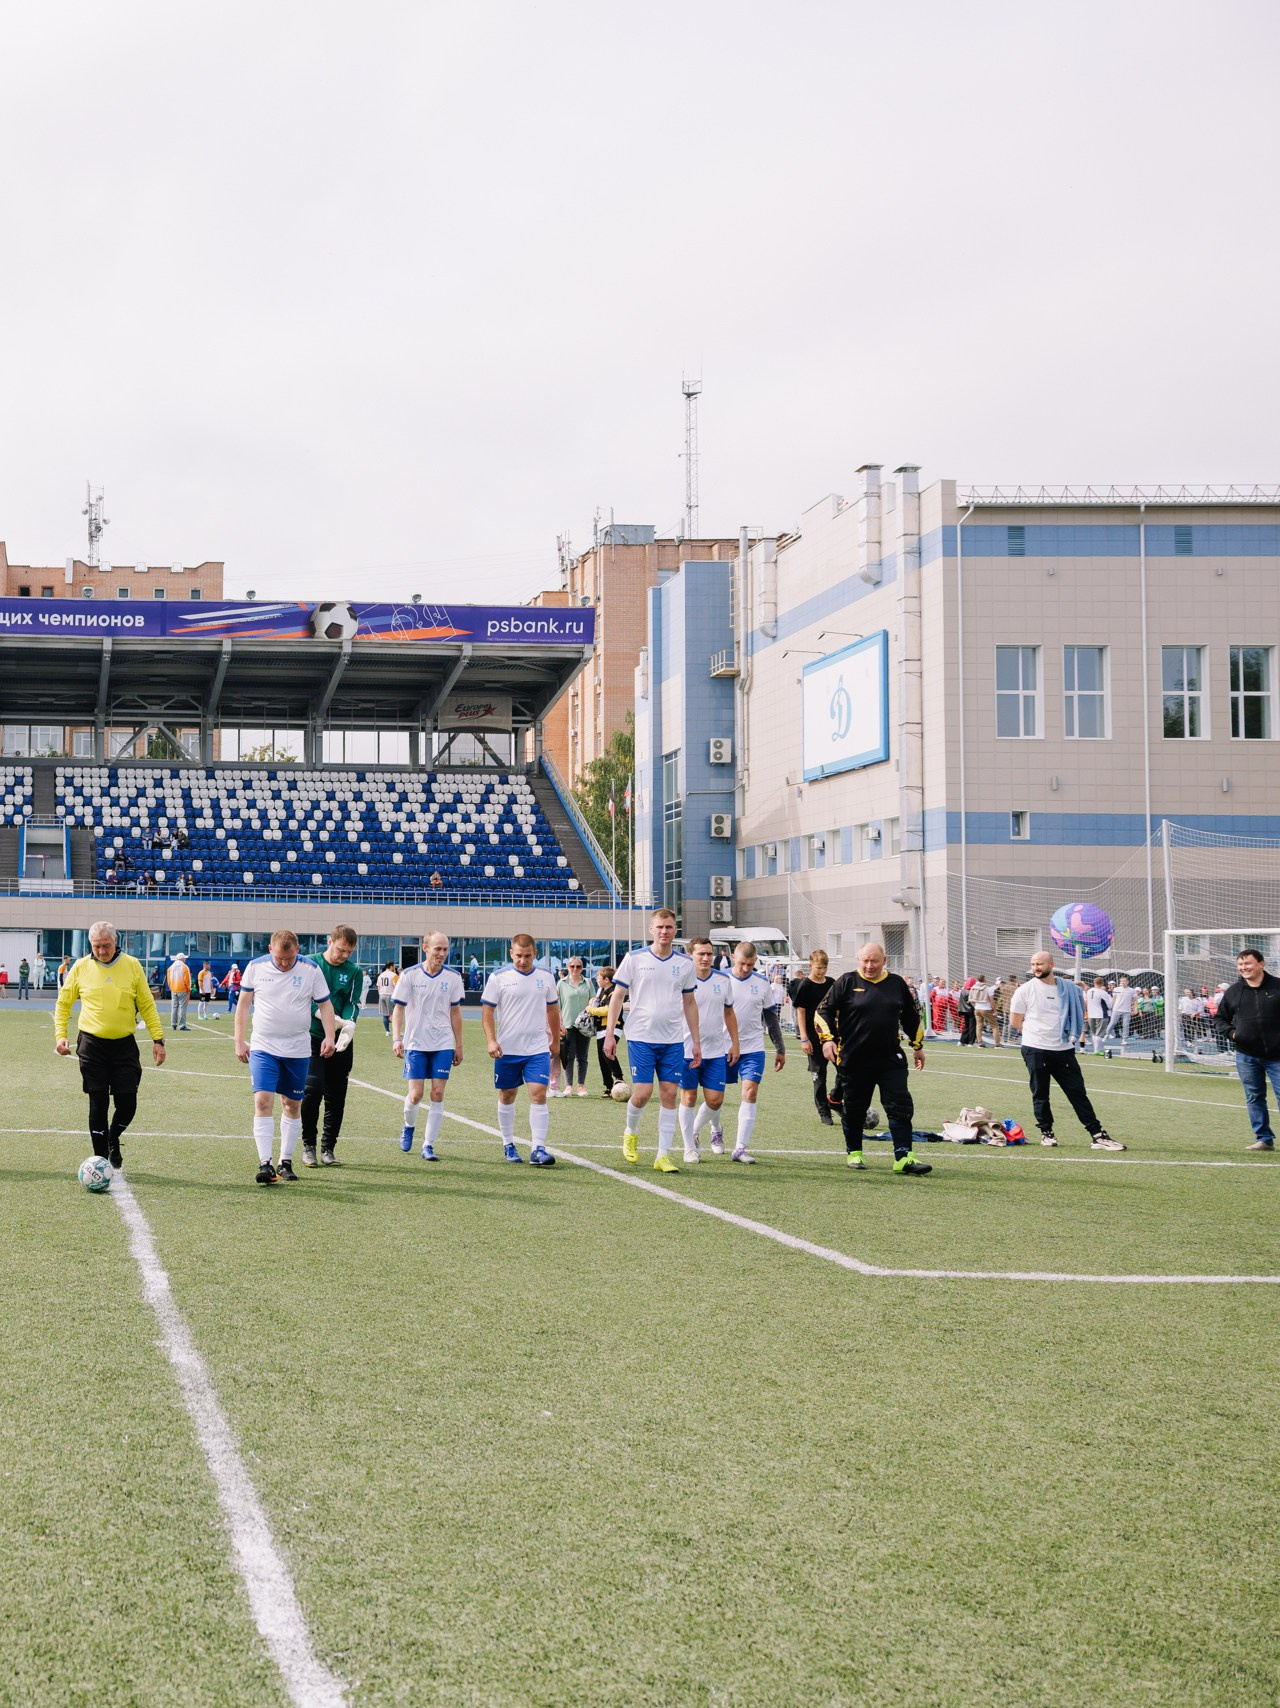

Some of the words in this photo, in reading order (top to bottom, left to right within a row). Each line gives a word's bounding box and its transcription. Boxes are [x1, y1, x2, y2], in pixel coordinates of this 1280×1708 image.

[38, 611, 145, 627] чемпионов
[487, 617, 584, 636] psbank.ru
[381, 977, 389, 987] 10
